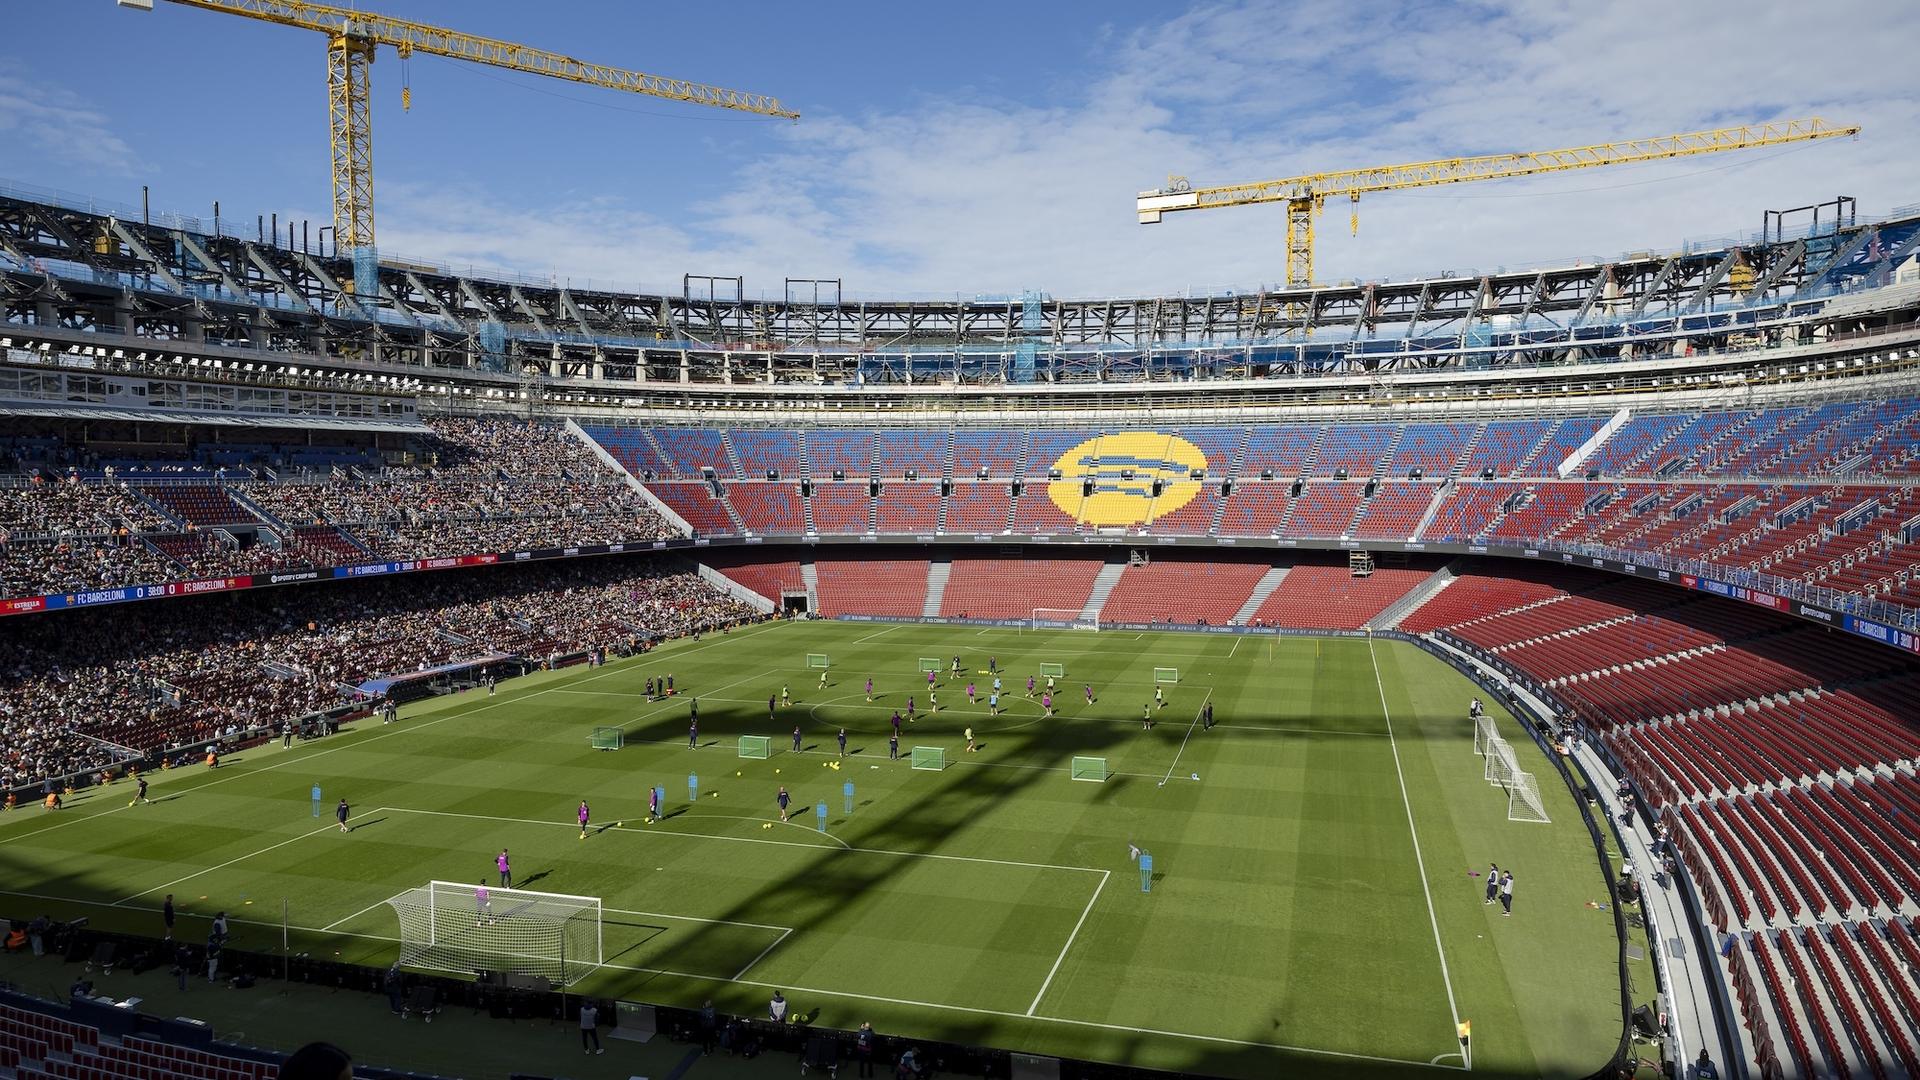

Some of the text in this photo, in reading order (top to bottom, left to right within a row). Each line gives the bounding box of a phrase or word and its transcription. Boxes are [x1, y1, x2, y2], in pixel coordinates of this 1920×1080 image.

[77, 594, 87, 605] FC
[88, 590, 126, 603] BARCELONA
[137, 588, 144, 598] 0
[168, 584, 176, 595] 0
[184, 584, 192, 593] FC
[193, 580, 226, 592] BARCELONA
[14, 600, 40, 609] ESTRELLA
